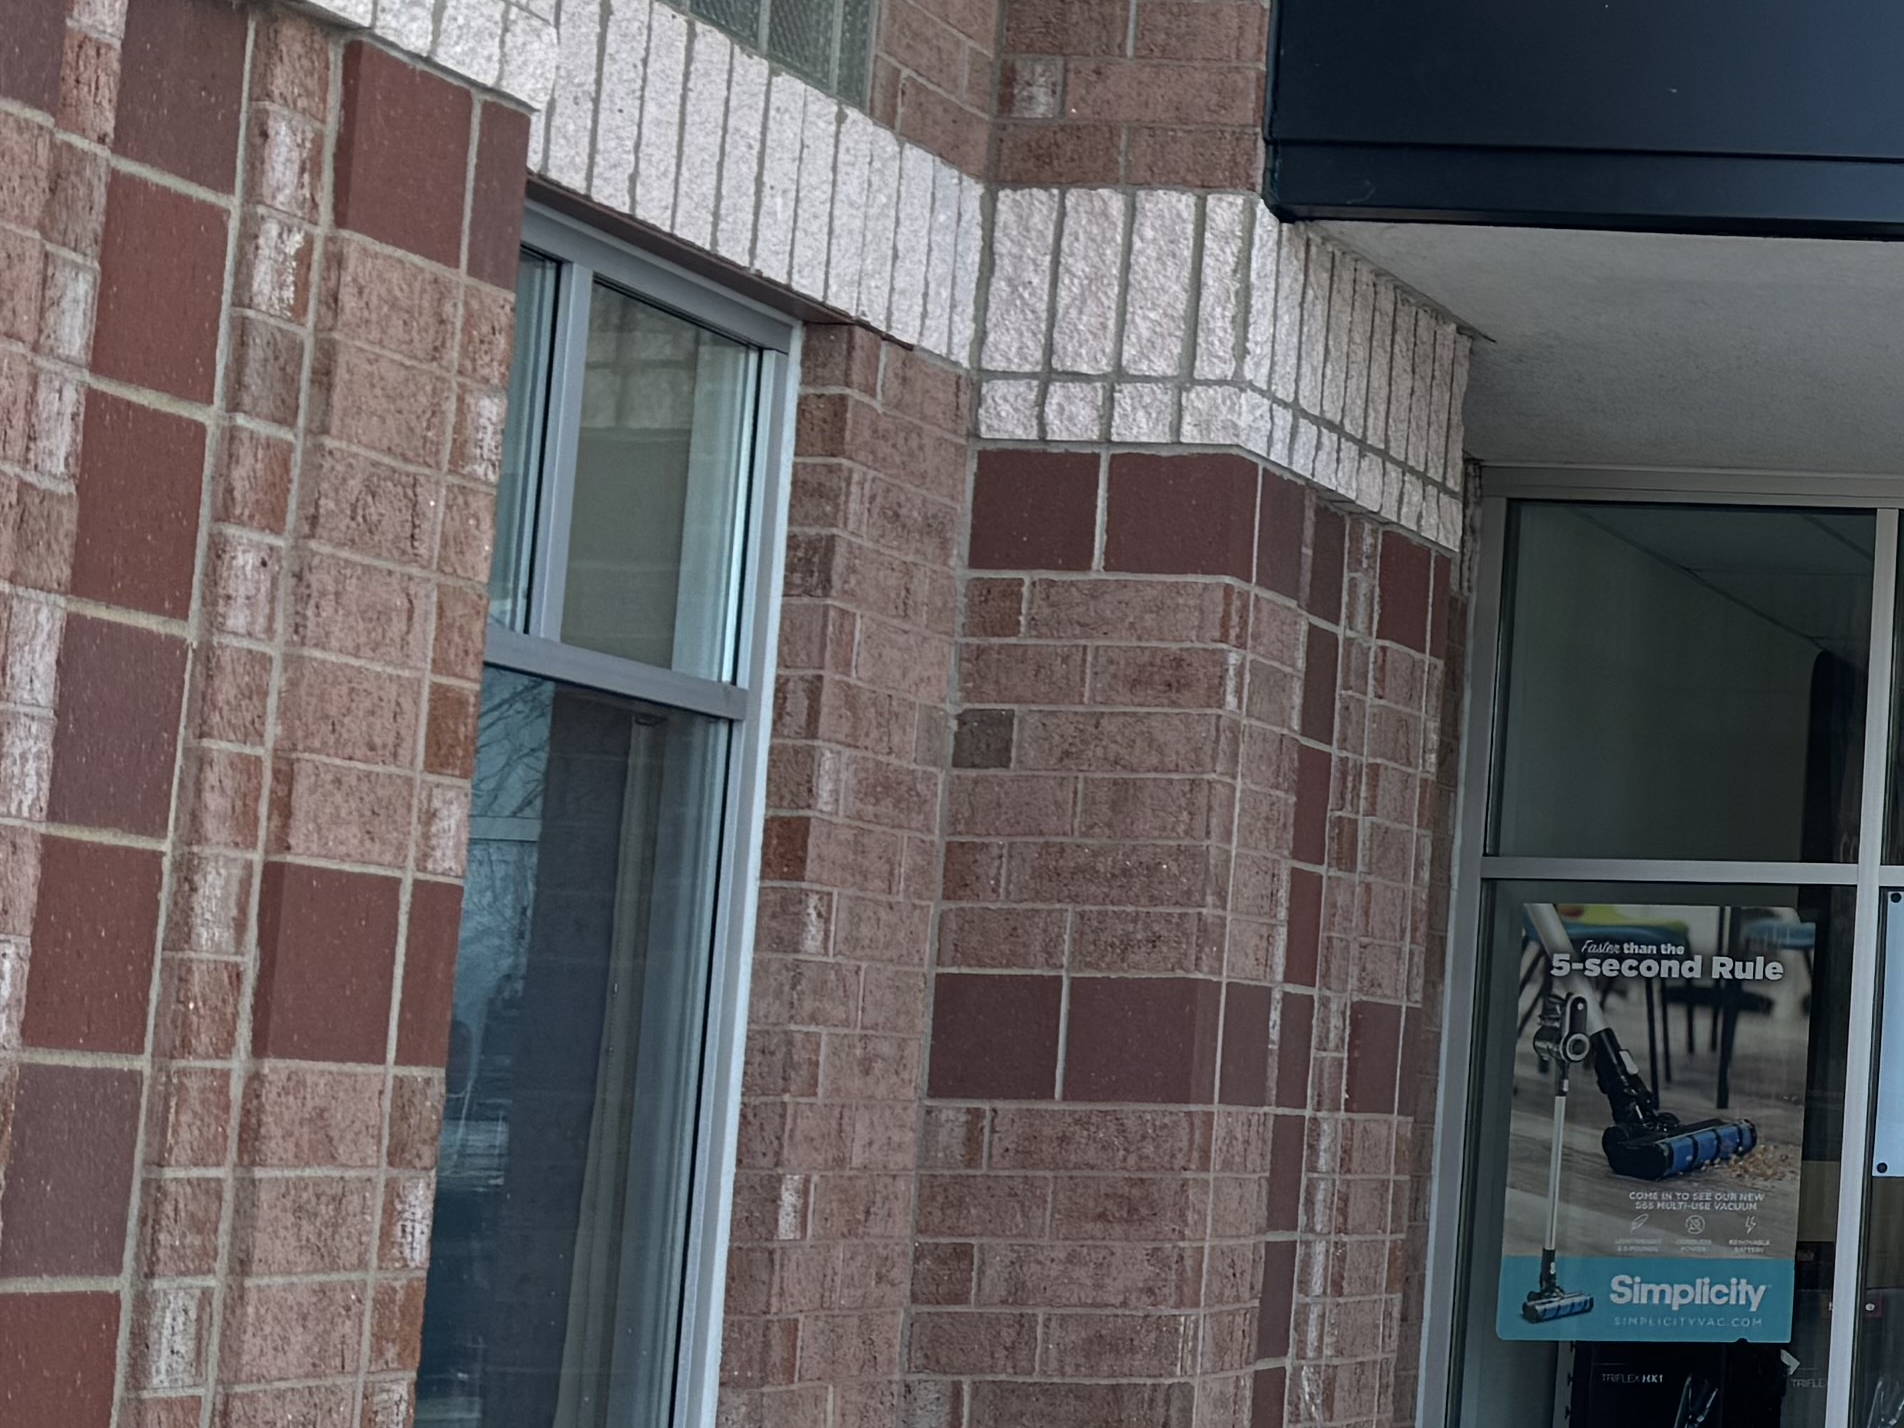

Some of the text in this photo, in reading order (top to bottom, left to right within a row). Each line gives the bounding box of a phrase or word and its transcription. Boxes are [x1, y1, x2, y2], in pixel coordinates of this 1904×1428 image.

[1581, 939, 1684, 954] Faster than the
[1550, 953, 1784, 980] 5-second Rule
[1629, 1192, 1766, 1202] COME IN TO SEE OUR NEW
[1657, 1202, 1710, 1210] MULTI-USE
[1714, 1202, 1758, 1212] VACUUM
[1609, 1274, 1766, 1312] Simplicity
[1614, 1316, 1762, 1328] SIMPLICITYVAC.COM
